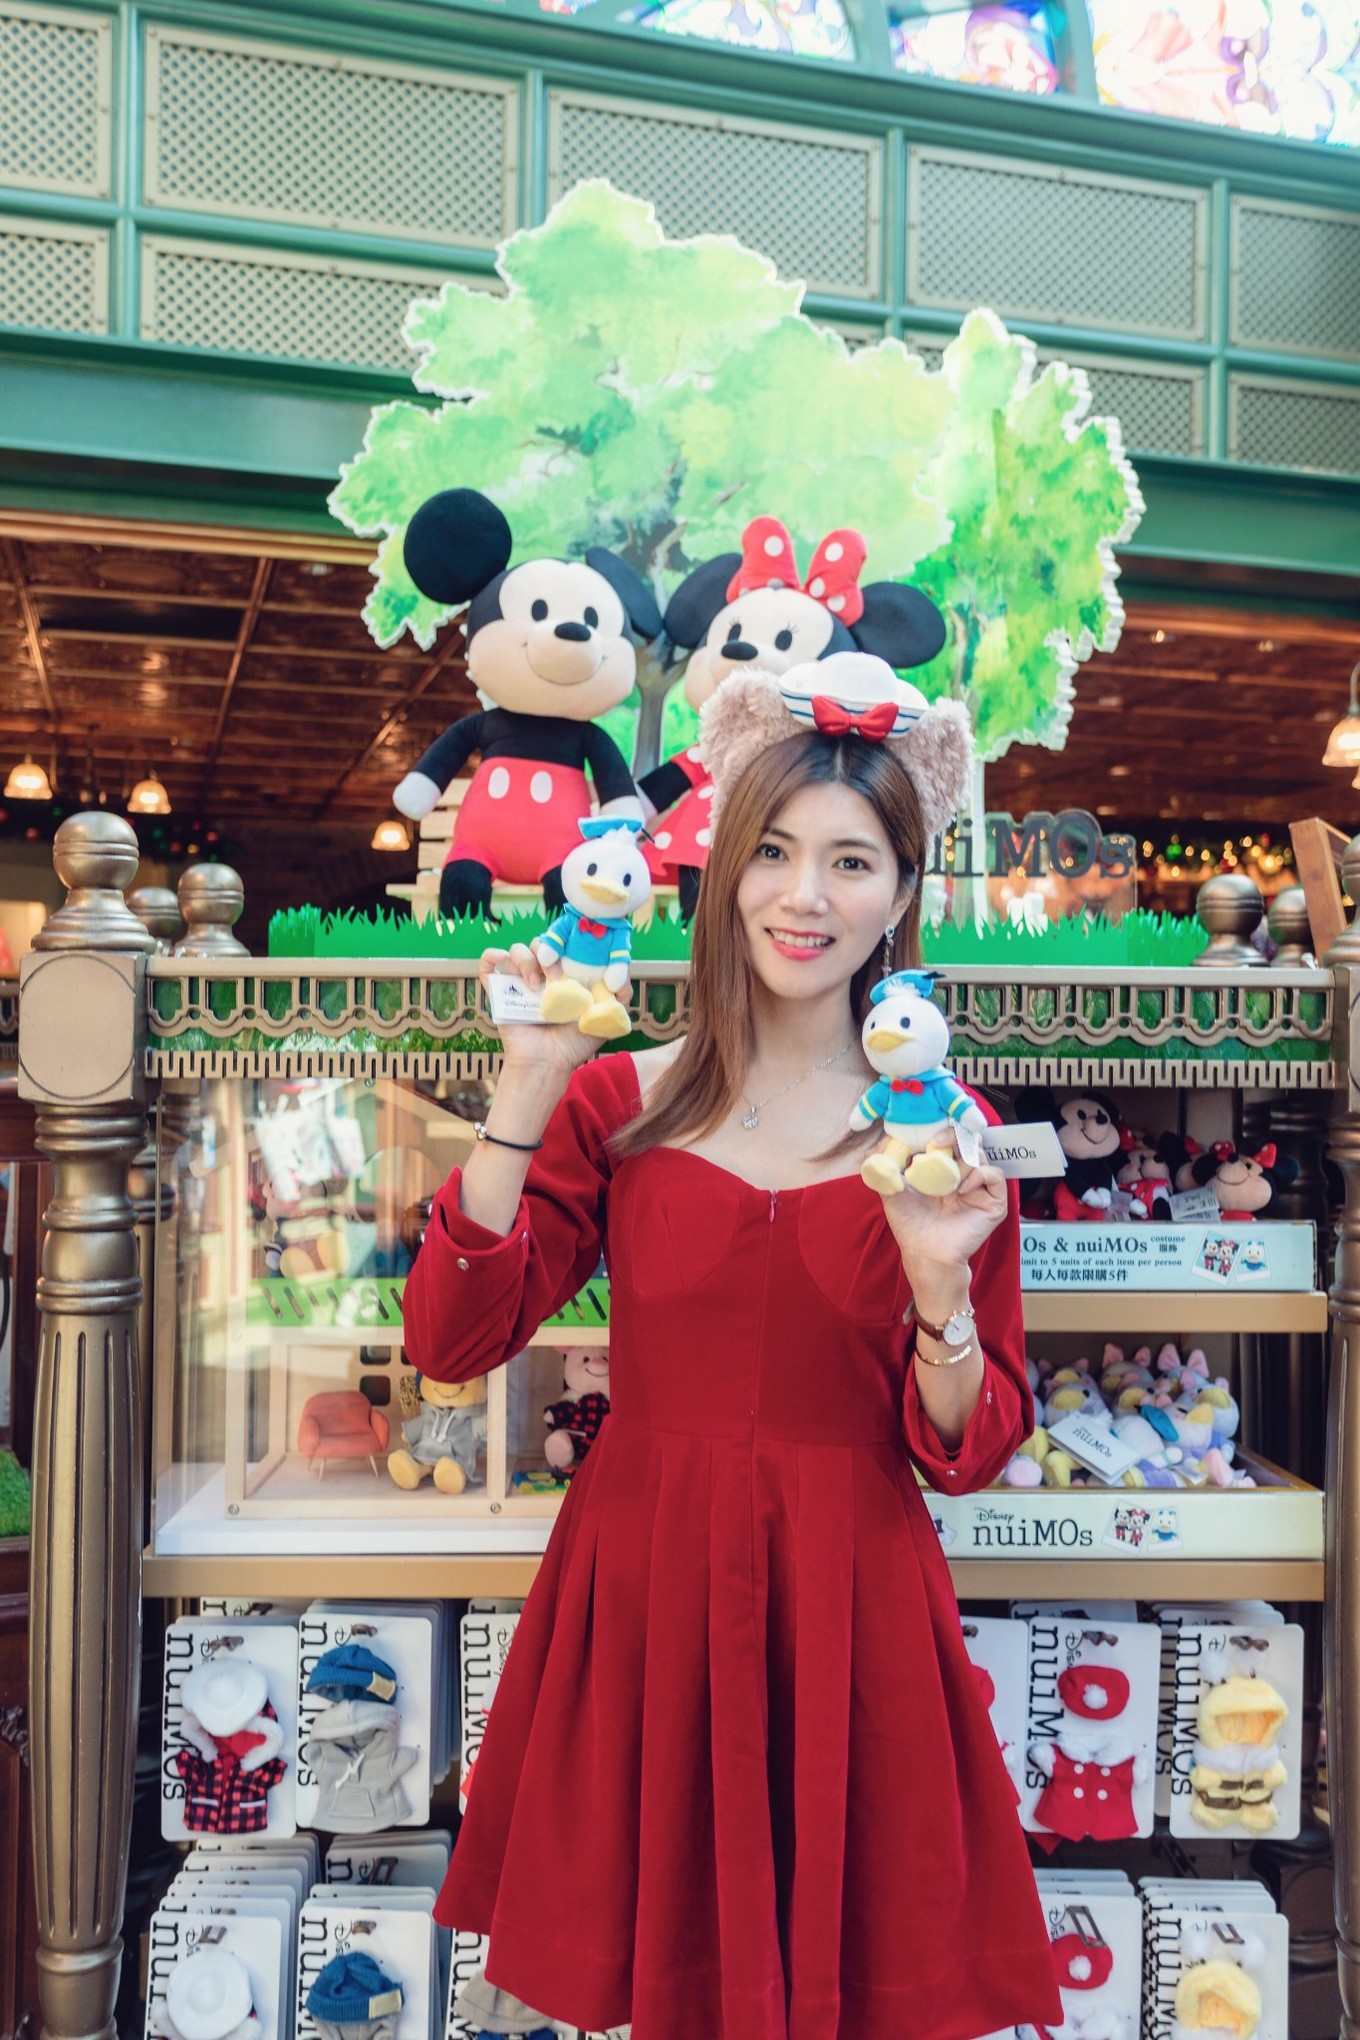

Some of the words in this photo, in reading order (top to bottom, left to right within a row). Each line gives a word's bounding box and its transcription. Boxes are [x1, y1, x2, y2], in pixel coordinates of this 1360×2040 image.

[925, 815, 1133, 878] iMOs
[988, 1146, 1037, 1161] uiMOs
[1023, 1236, 1046, 1252] Os
[1053, 1236, 1069, 1253] &
[1076, 1236, 1148, 1253] nuiMOs
[1150, 1235, 1186, 1243] costume
[1021, 1257, 1038, 1266] imit
[1040, 1258, 1048, 1266] to
[1052, 1258, 1057, 1266] 5
[1060, 1258, 1080, 1266] units
[1083, 1257, 1092, 1266] of
[1095, 1257, 1114, 1266] each
[1117, 1257, 1135, 1266] item
[1137, 1259, 1151, 1268] per
[1154, 1259, 1182, 1268] person
[973, 1506, 1015, 1524] Disney
[972, 1518, 1093, 1546] nuiMOs
[1026, 1625, 1065, 1789] nuiMs
